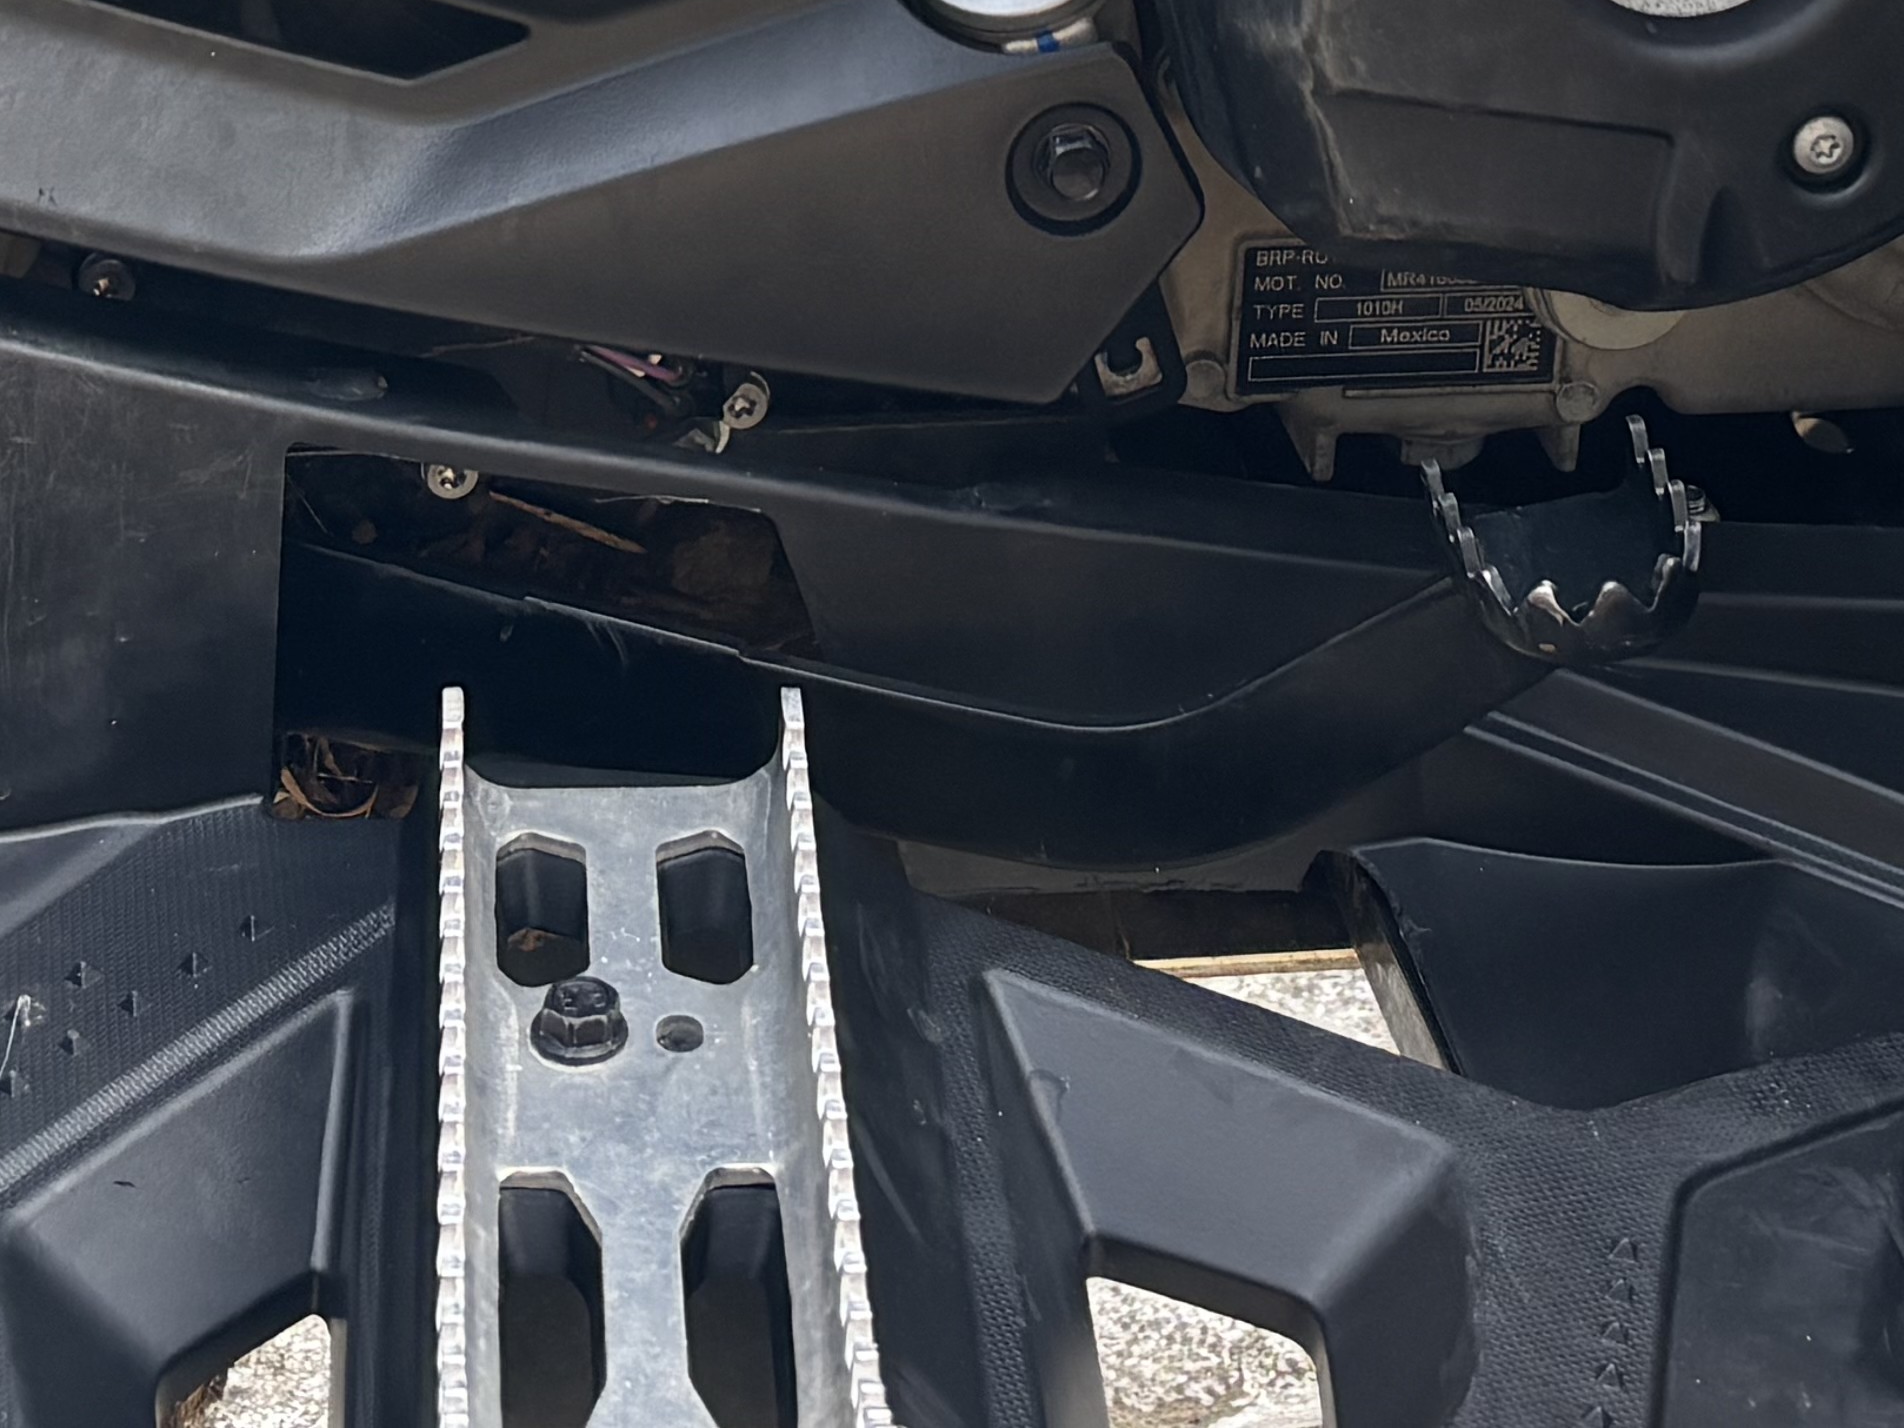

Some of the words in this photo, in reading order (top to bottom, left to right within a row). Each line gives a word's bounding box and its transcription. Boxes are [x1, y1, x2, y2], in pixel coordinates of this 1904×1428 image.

[1253, 303, 1305, 320] TYPE
[1464, 294, 1525, 313] 05/2024
[1249, 331, 1307, 349] MADE
[1319, 330, 1339, 346] IN
[1379, 327, 1451, 344] Mexico
